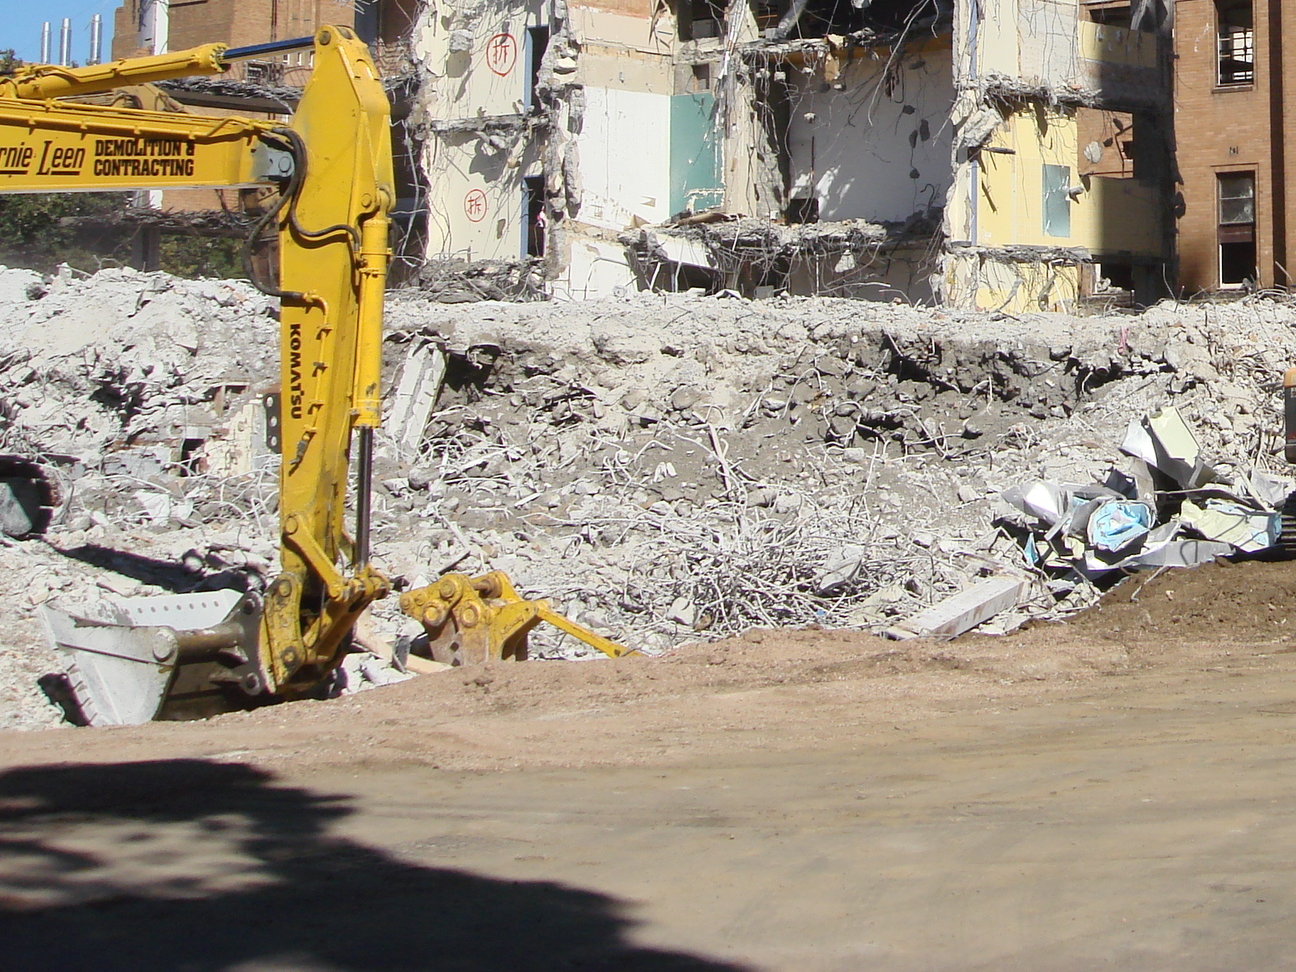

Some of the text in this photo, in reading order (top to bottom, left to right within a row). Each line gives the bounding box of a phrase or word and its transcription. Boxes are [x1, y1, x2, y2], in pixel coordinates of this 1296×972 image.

[36, 140, 86, 176] Leen
[94, 138, 195, 157] DEMOLITION &
[93, 158, 194, 177] CONTRACTING
[289, 323, 304, 420] KOMATSU
